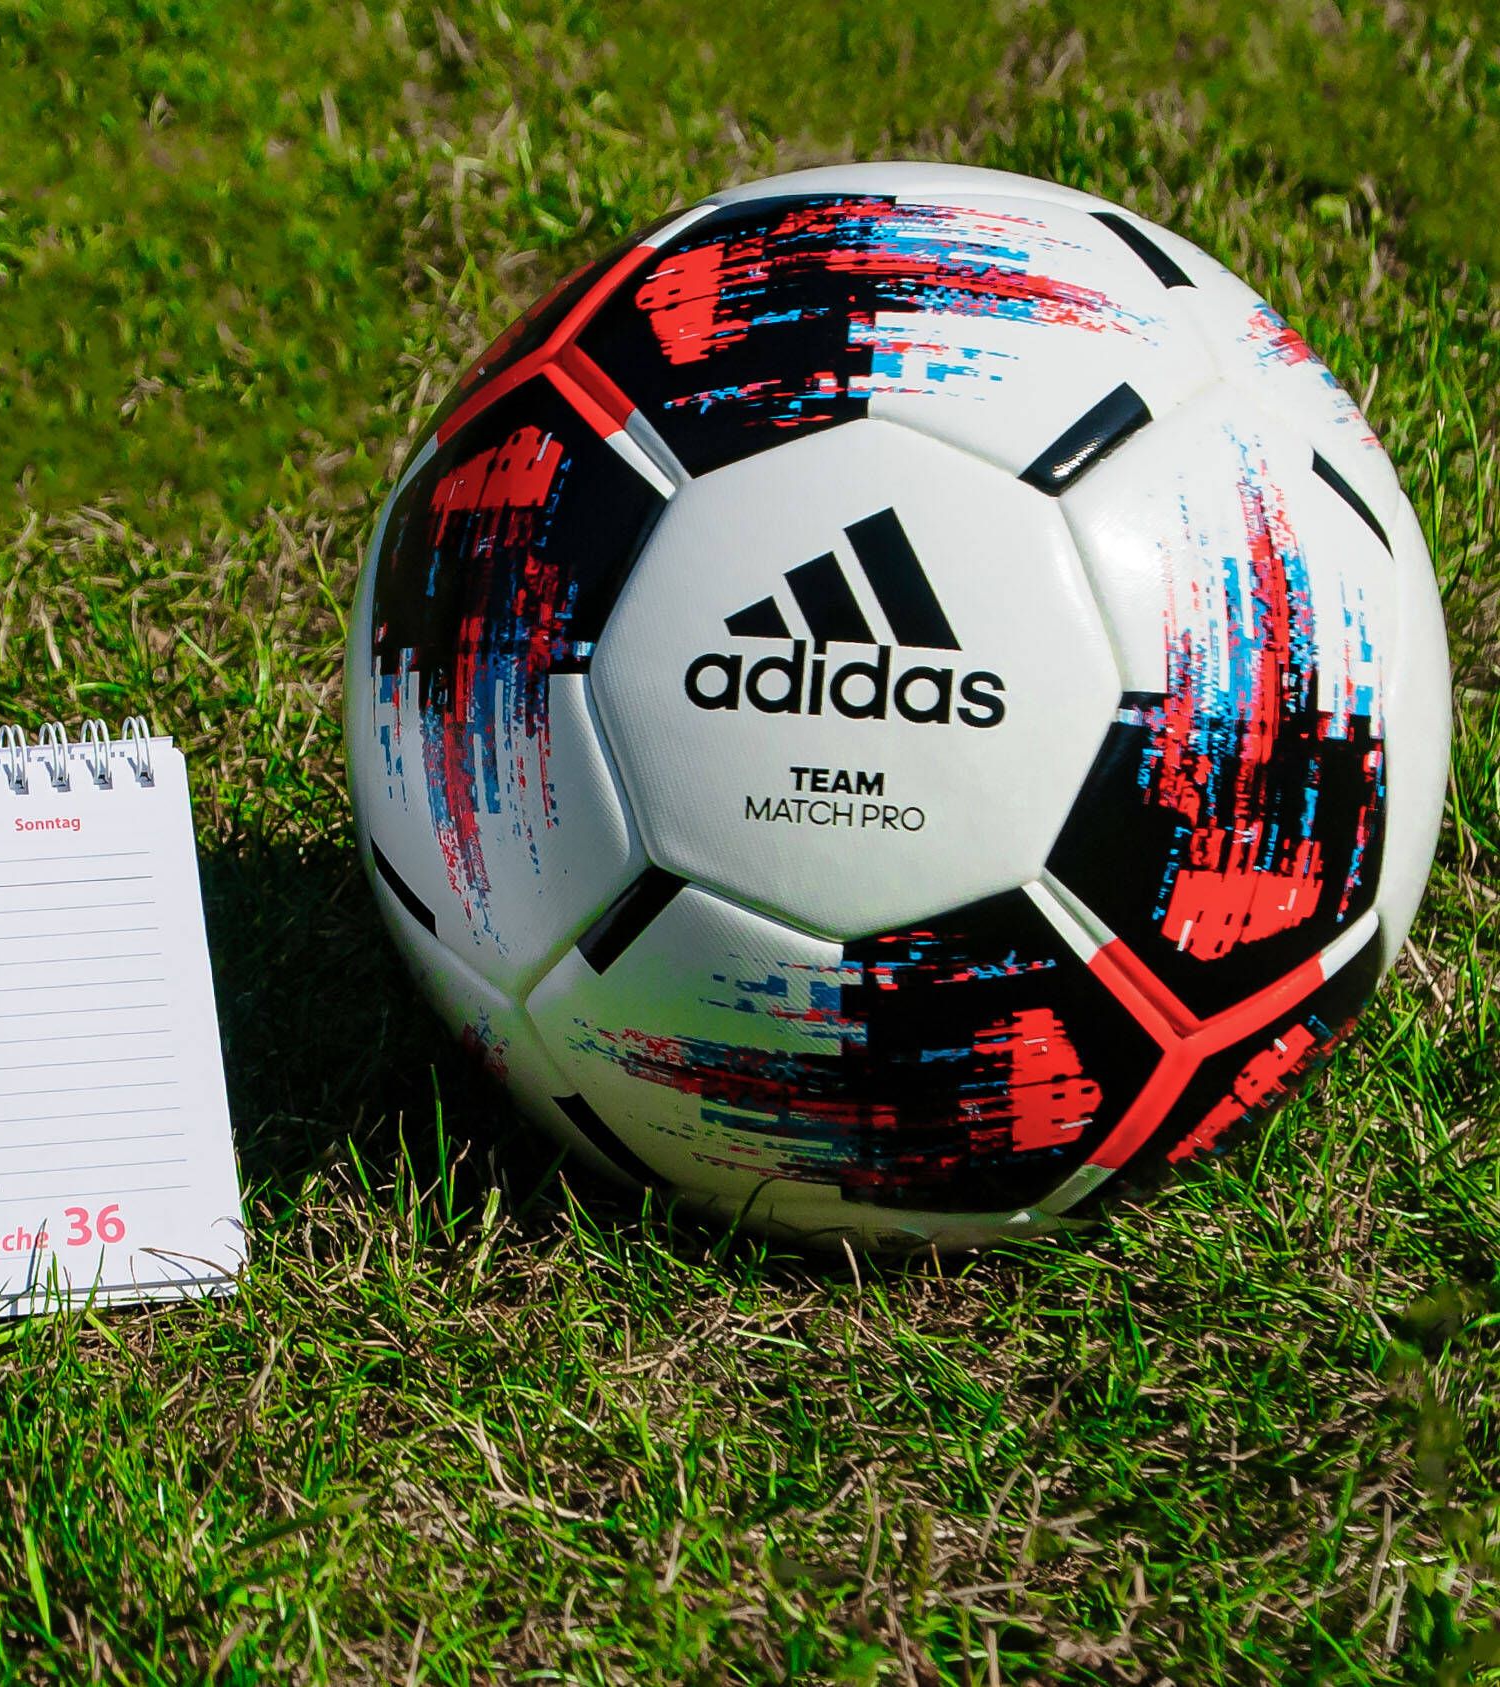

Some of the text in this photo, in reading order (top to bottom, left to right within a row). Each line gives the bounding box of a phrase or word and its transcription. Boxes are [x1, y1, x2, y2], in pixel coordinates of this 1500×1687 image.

[684, 638, 1007, 729] adidas
[790, 766, 885, 796] TEAM
[15, 815, 81, 833] Sonntag
[744, 796, 925, 832] MATCH PRO
[64, 1203, 126, 1247] 36
